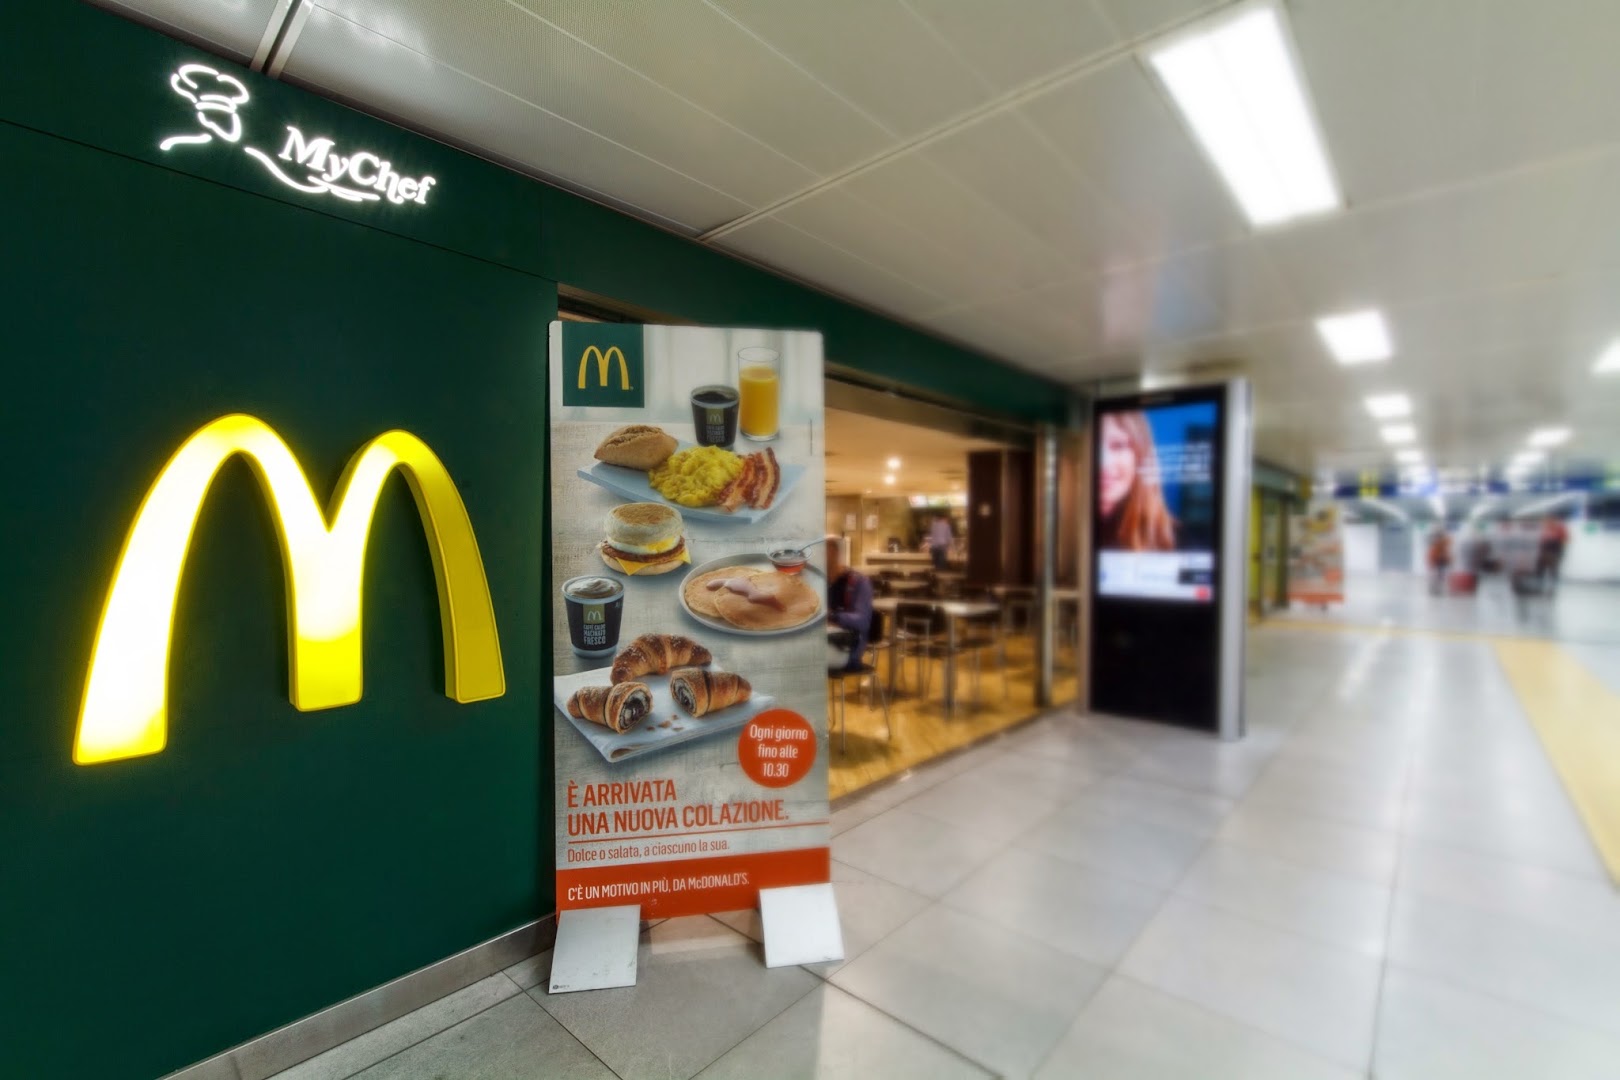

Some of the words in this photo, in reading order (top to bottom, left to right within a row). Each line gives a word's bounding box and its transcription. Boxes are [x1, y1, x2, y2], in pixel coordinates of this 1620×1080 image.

[278, 125, 436, 205] MyChef
[583, 636, 606, 646] FRESCO
[750, 724, 774, 742] Ogni
[775, 725, 809, 742] giorno
[758, 743, 778, 758] fino
[779, 744, 799, 759] alle
[763, 762, 790, 778] 10.30
[567, 779, 579, 808] È
[583, 779, 677, 807] ARRIVATA
[567, 812, 610, 837] UNA
[614, 807, 679, 833] NUOVA
[682, 799, 789, 828] COLAZIONE.
[567, 848, 597, 863] Dolce
[600, 851, 606, 860] o
[608, 844, 642, 861] salata,
[644, 847, 650, 857] a
[652, 841, 697, 857] ciascuno
[699, 839, 708, 852] la
[710, 839, 730, 851] sua.
[568, 883, 584, 901] C'È
[585, 886, 600, 900] UN
[602, 882, 639, 898] MOTIVO
[640, 881, 651, 895] IN
[652, 876, 671, 893] PIÙ,
[672, 878, 686, 892] DA
[688, 872, 750, 890] McDONALD'S.
